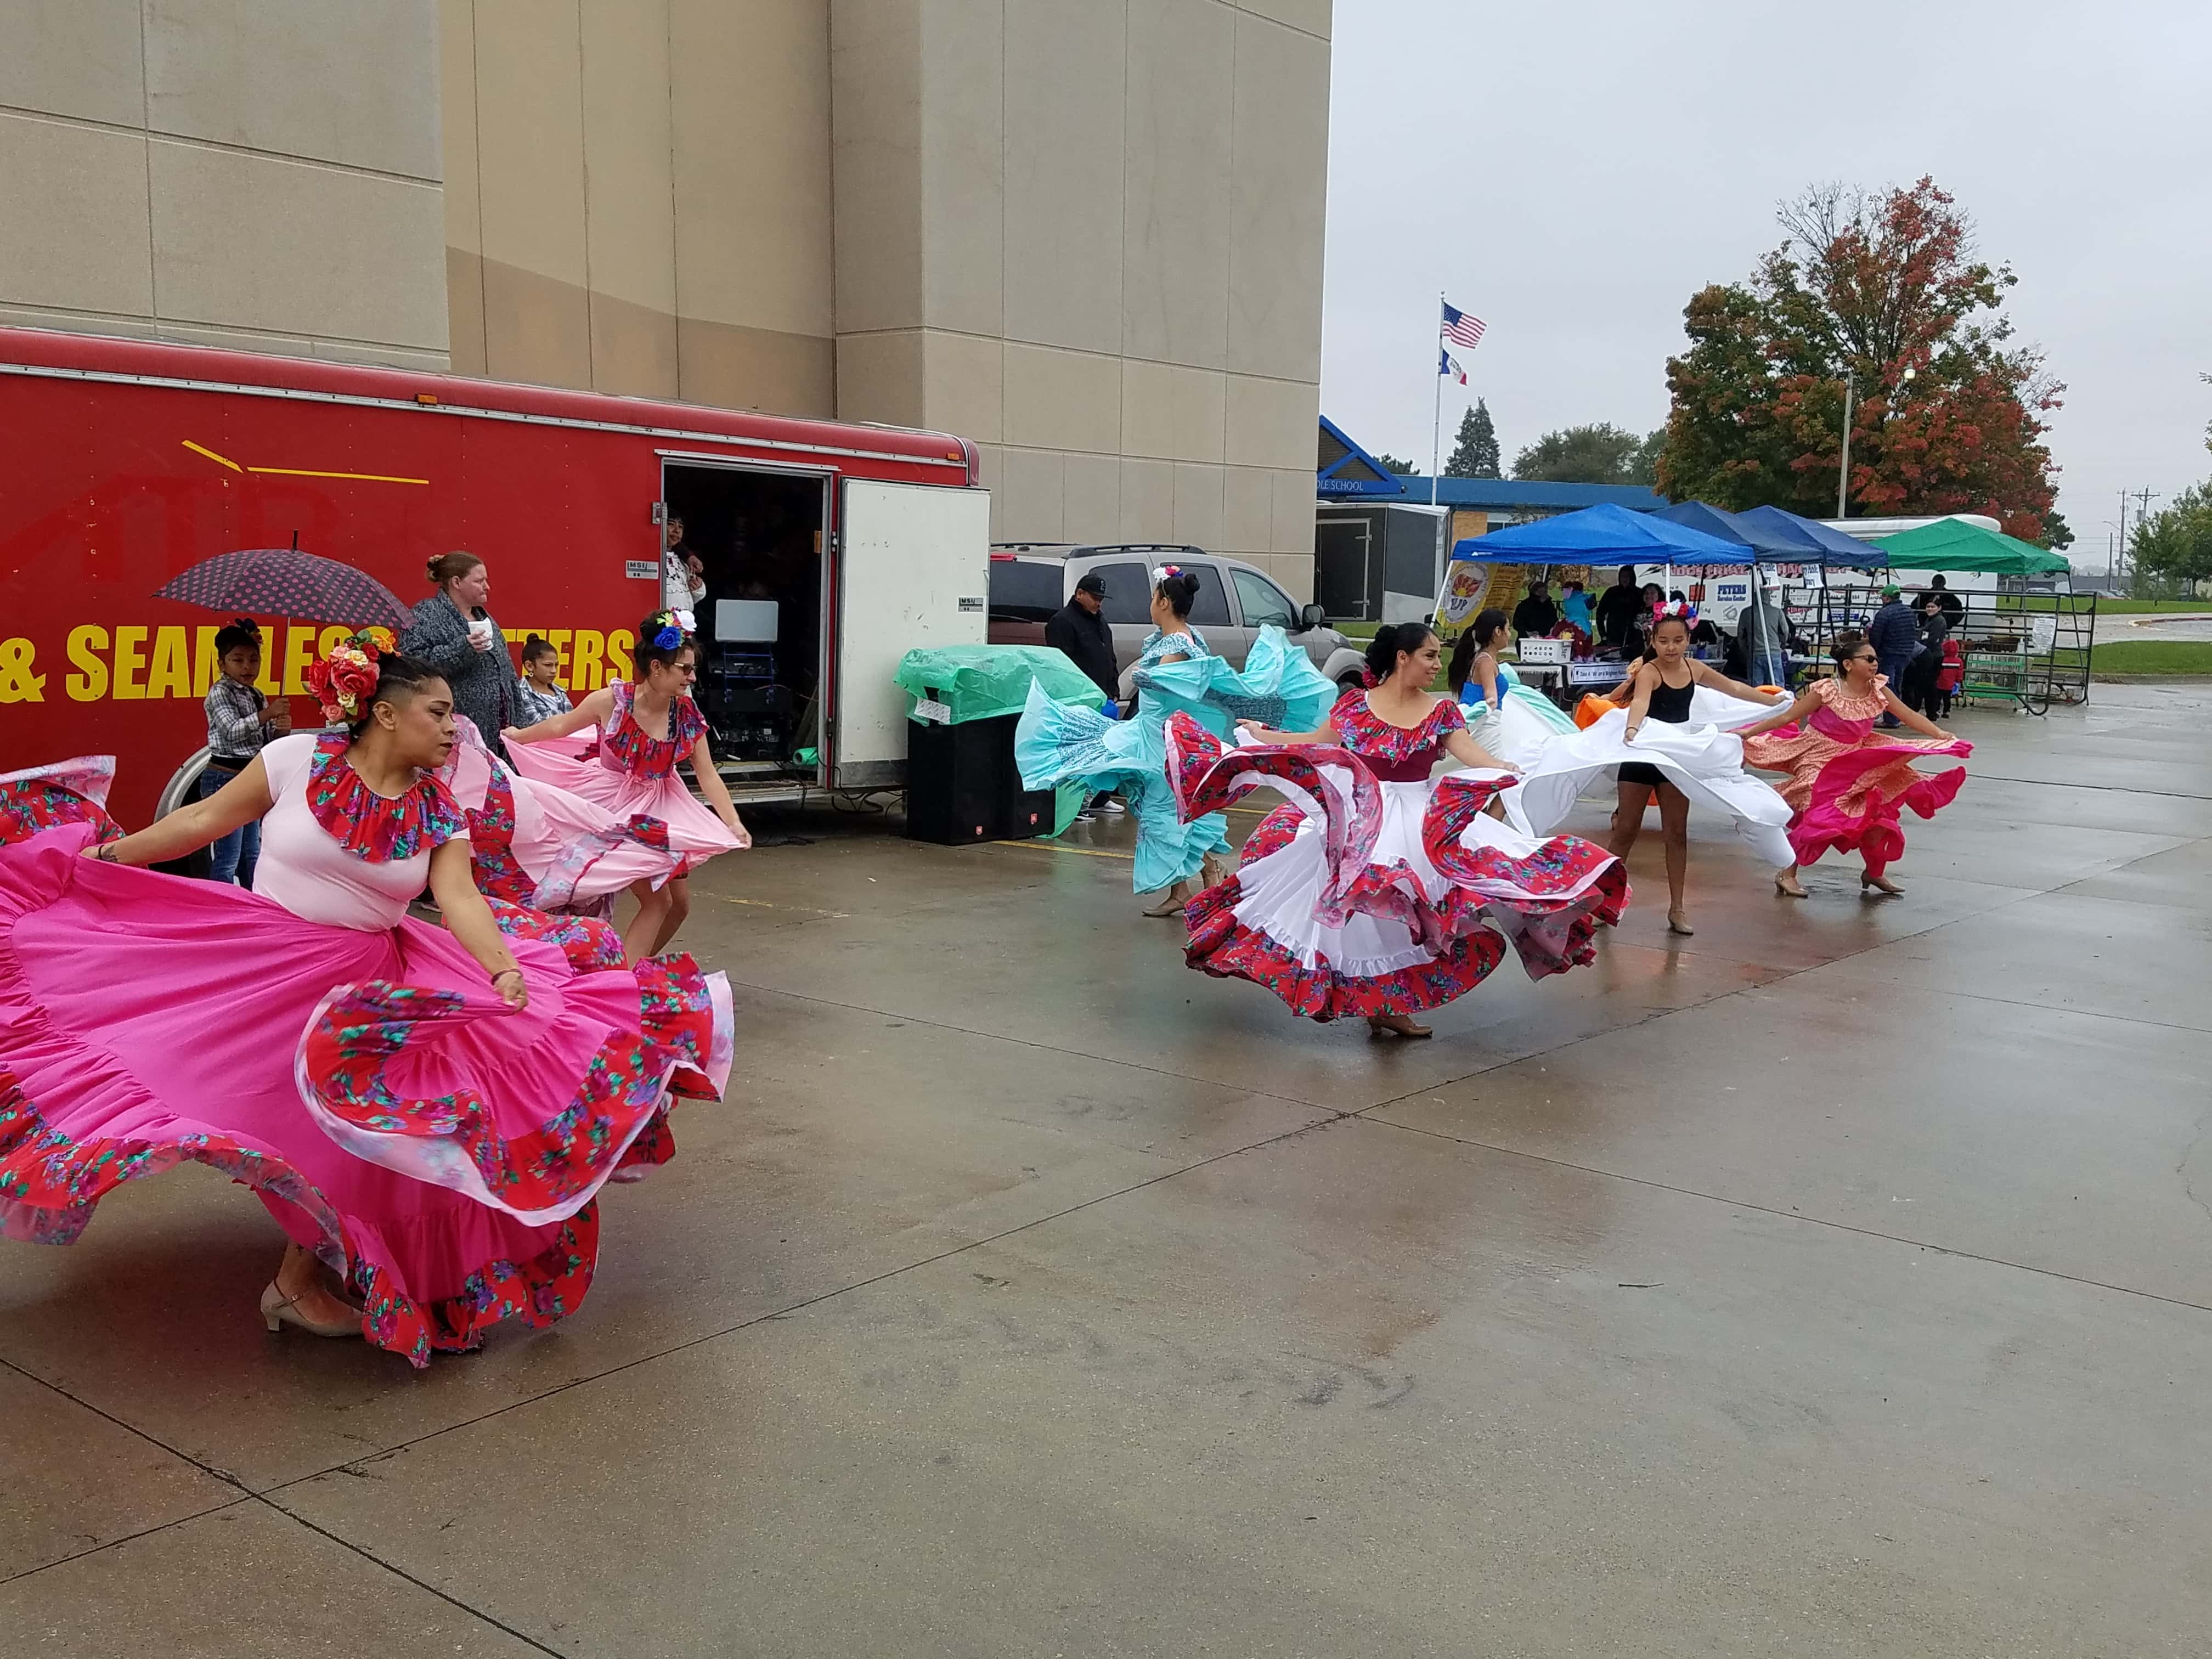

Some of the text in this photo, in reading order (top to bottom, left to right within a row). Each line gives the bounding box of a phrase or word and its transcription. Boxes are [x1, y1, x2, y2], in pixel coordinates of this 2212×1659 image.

[1331, 481, 1364, 491] SCHOOL
[1718, 585, 1746, 595] PETERS
[0, 637, 46, 703] &
[66, 624, 391, 702] SEALE
